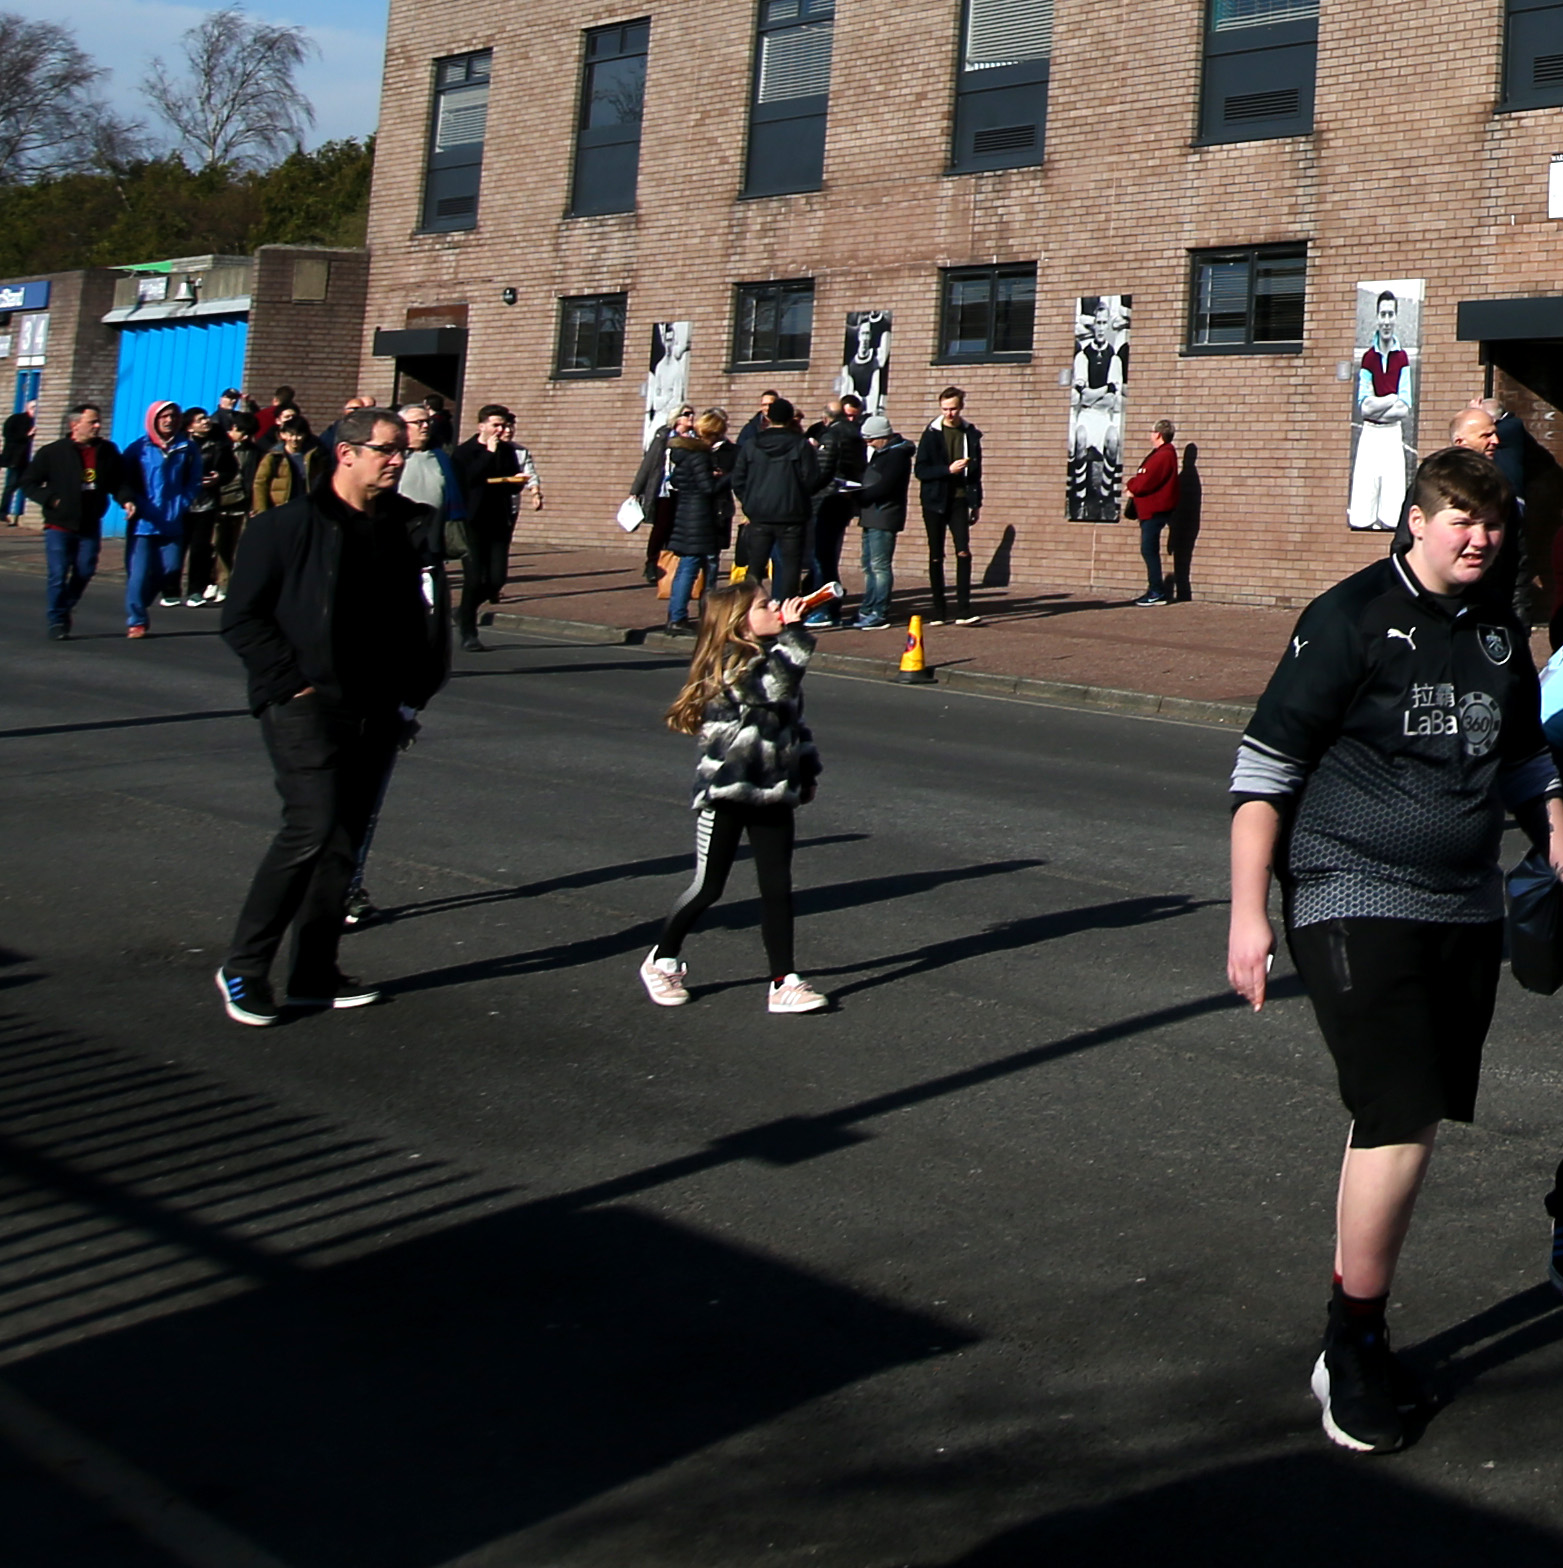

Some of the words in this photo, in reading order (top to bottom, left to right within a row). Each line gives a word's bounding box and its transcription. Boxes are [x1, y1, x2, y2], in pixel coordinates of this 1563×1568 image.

[22, 322, 32, 350] 3
[34, 321, 44, 349] 4
[1403, 710, 1458, 736] LaBa
[1463, 715, 1490, 732] 360
